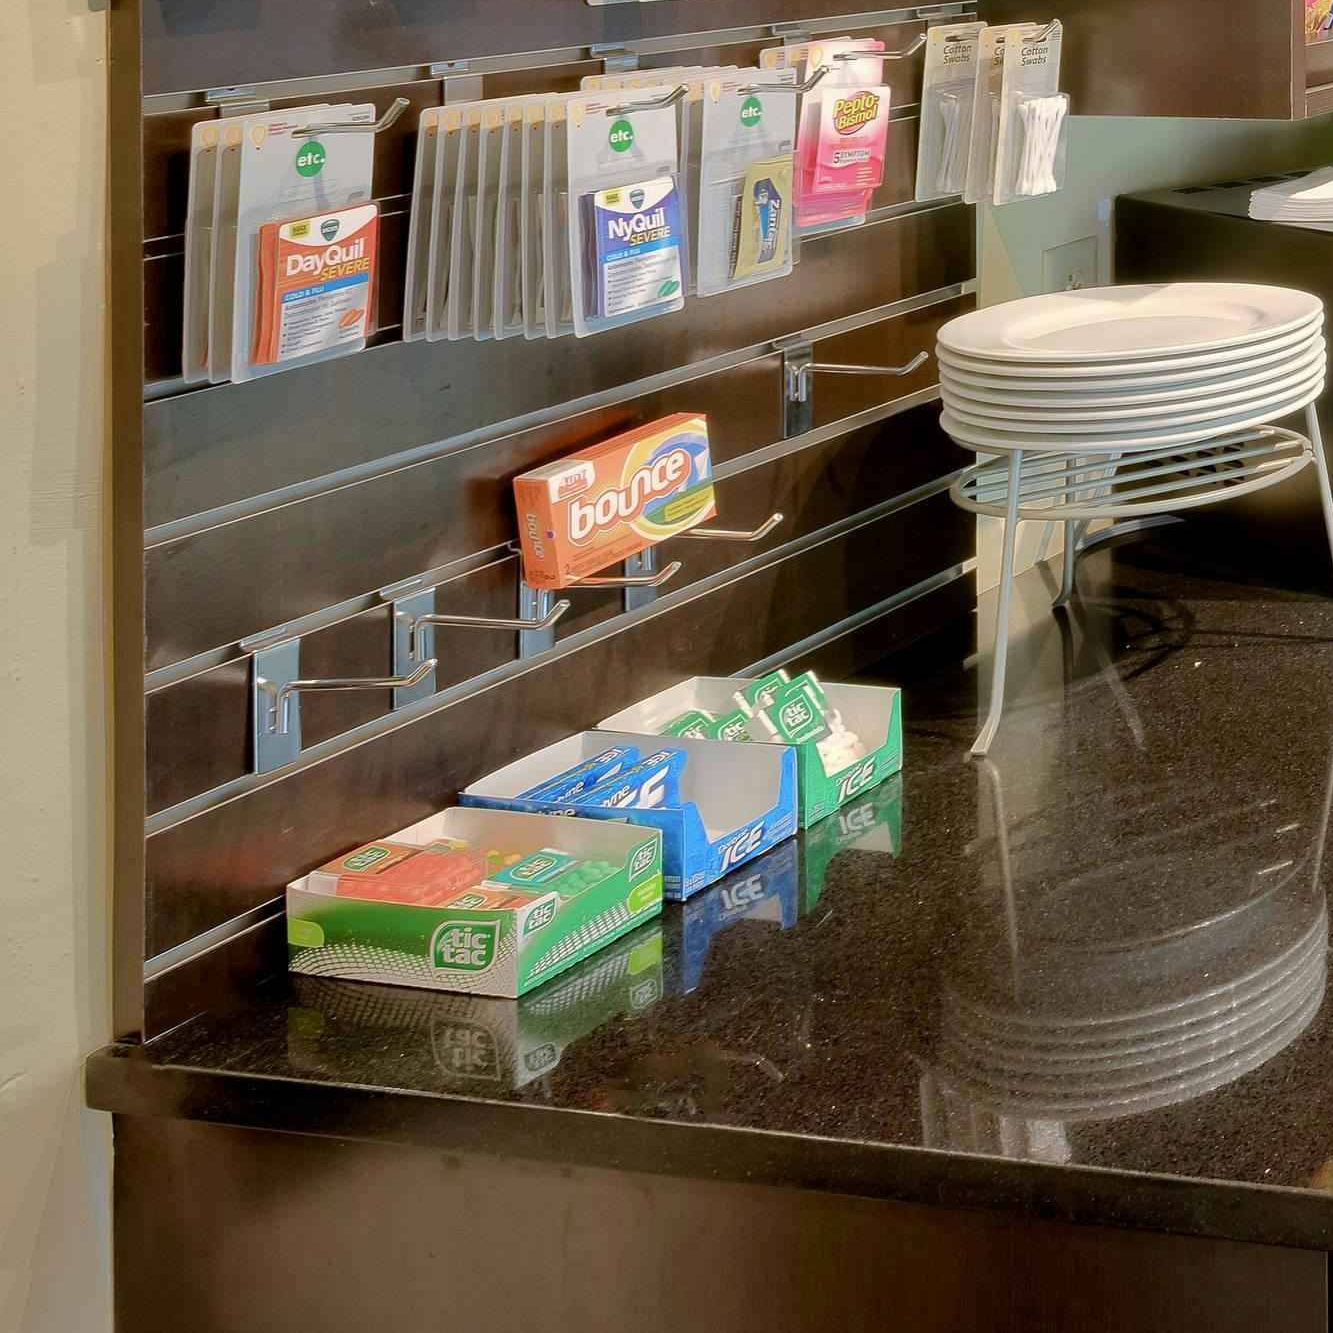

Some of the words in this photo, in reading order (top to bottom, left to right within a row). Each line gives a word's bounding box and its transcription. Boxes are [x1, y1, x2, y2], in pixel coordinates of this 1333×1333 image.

[943, 44, 972, 56] Cotton
[943, 53, 970, 65] Swabs
[1021, 46, 1048, 57] Cotton
[1021, 54, 1047, 66] Swabs
[741, 106, 762, 119] etc.
[832, 91, 880, 120] Pepto-
[837, 106, 879, 131] Bismol
[609, 130, 634, 143] etc.
[296, 151, 326, 168] etc.
[608, 207, 666, 242] NyQuil
[629, 226, 671, 247] SEVERE
[286, 237, 365, 277] DayQuil
[320, 257, 370, 282] SEVERE
[569, 451, 687, 541] bounce
[525, 512, 545, 561] bounce
[837, 756, 877, 804] ICE
[720, 820, 765, 872] ICE
[450, 927, 488, 950] tic
[442, 944, 488, 966] tac
